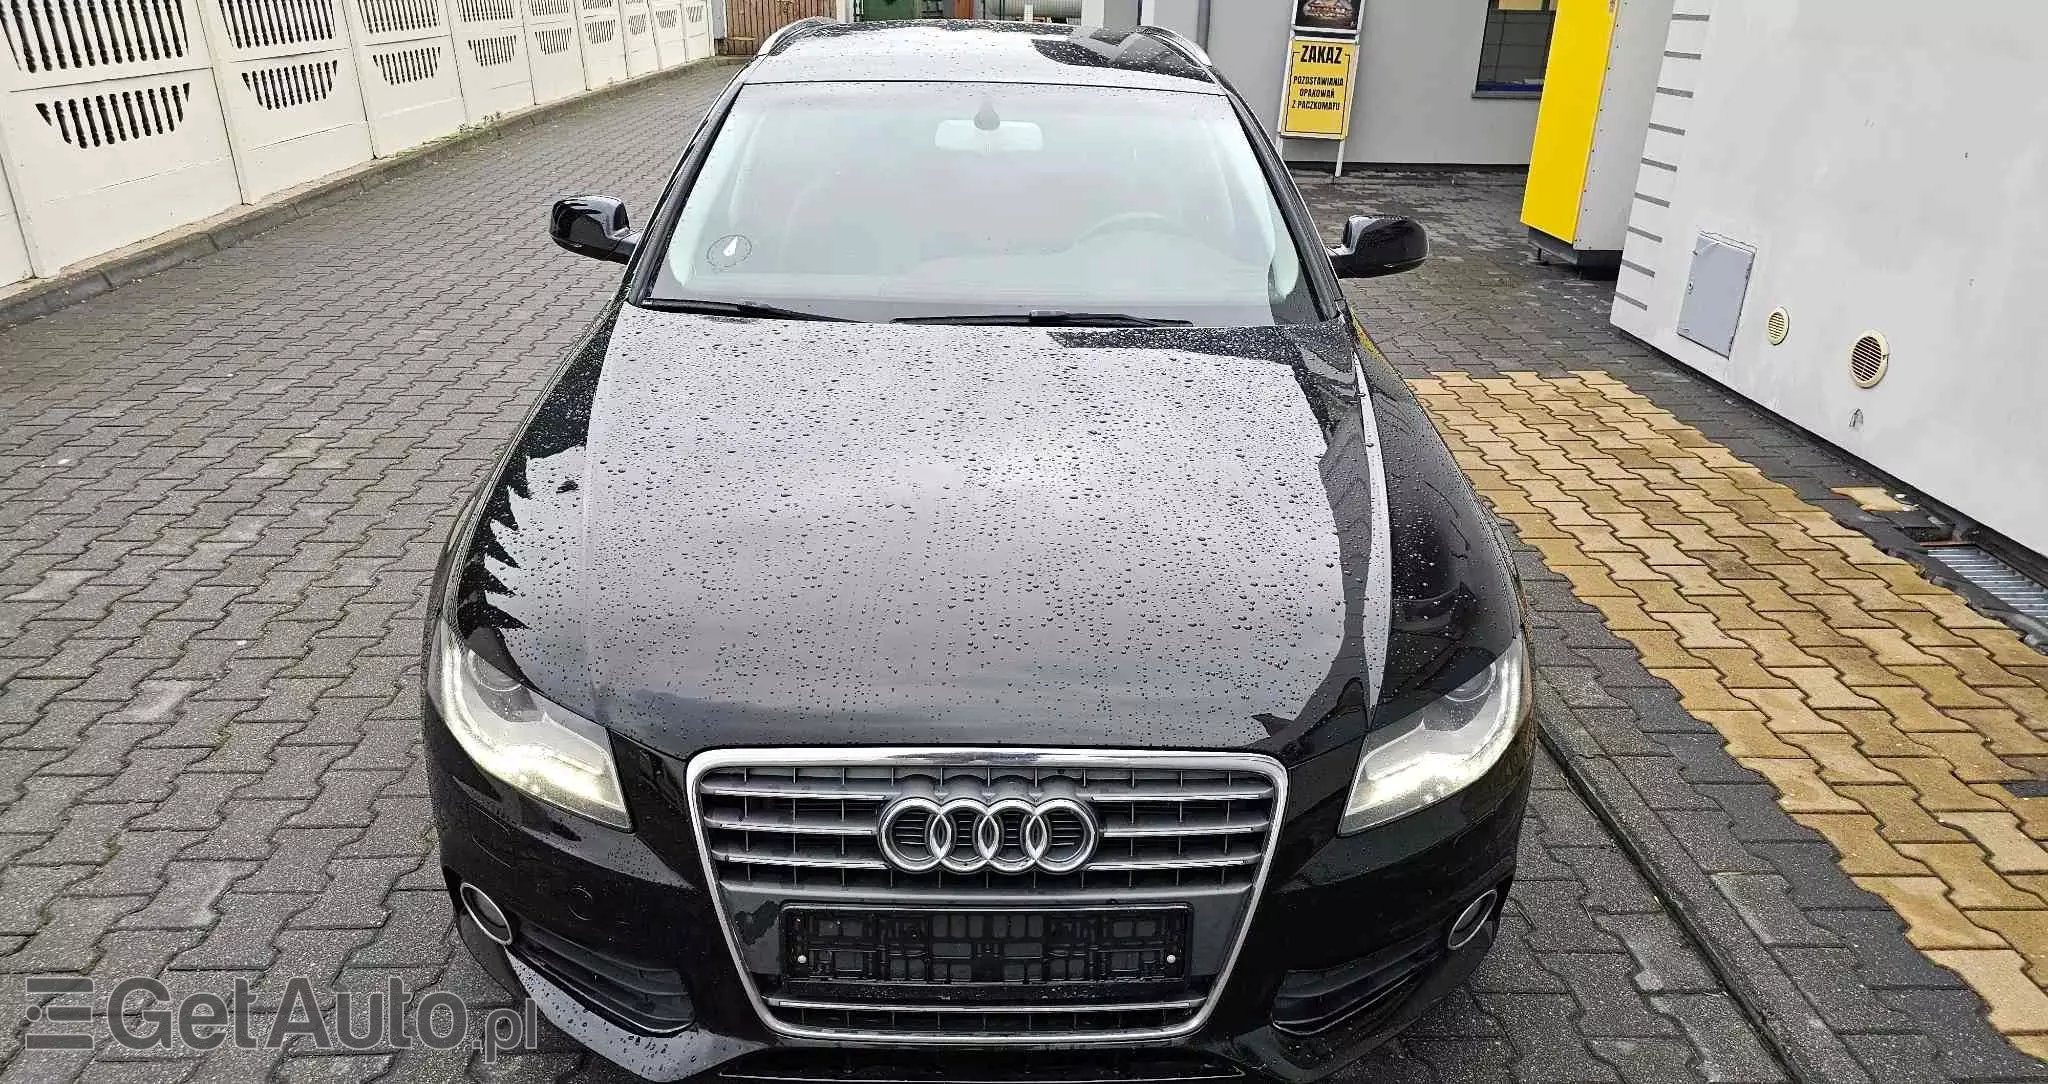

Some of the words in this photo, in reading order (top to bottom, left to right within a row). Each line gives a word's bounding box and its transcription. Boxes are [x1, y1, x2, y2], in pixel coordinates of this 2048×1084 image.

[1300, 45, 1343, 64] ZAKAZ
[1293, 76, 1344, 86] POZOSTAWIANIA
[1299, 88, 1335, 98] OPAKOWAŃ
[1292, 100, 1296, 109] Z
[1297, 101, 1340, 111] PACZKOMATU
